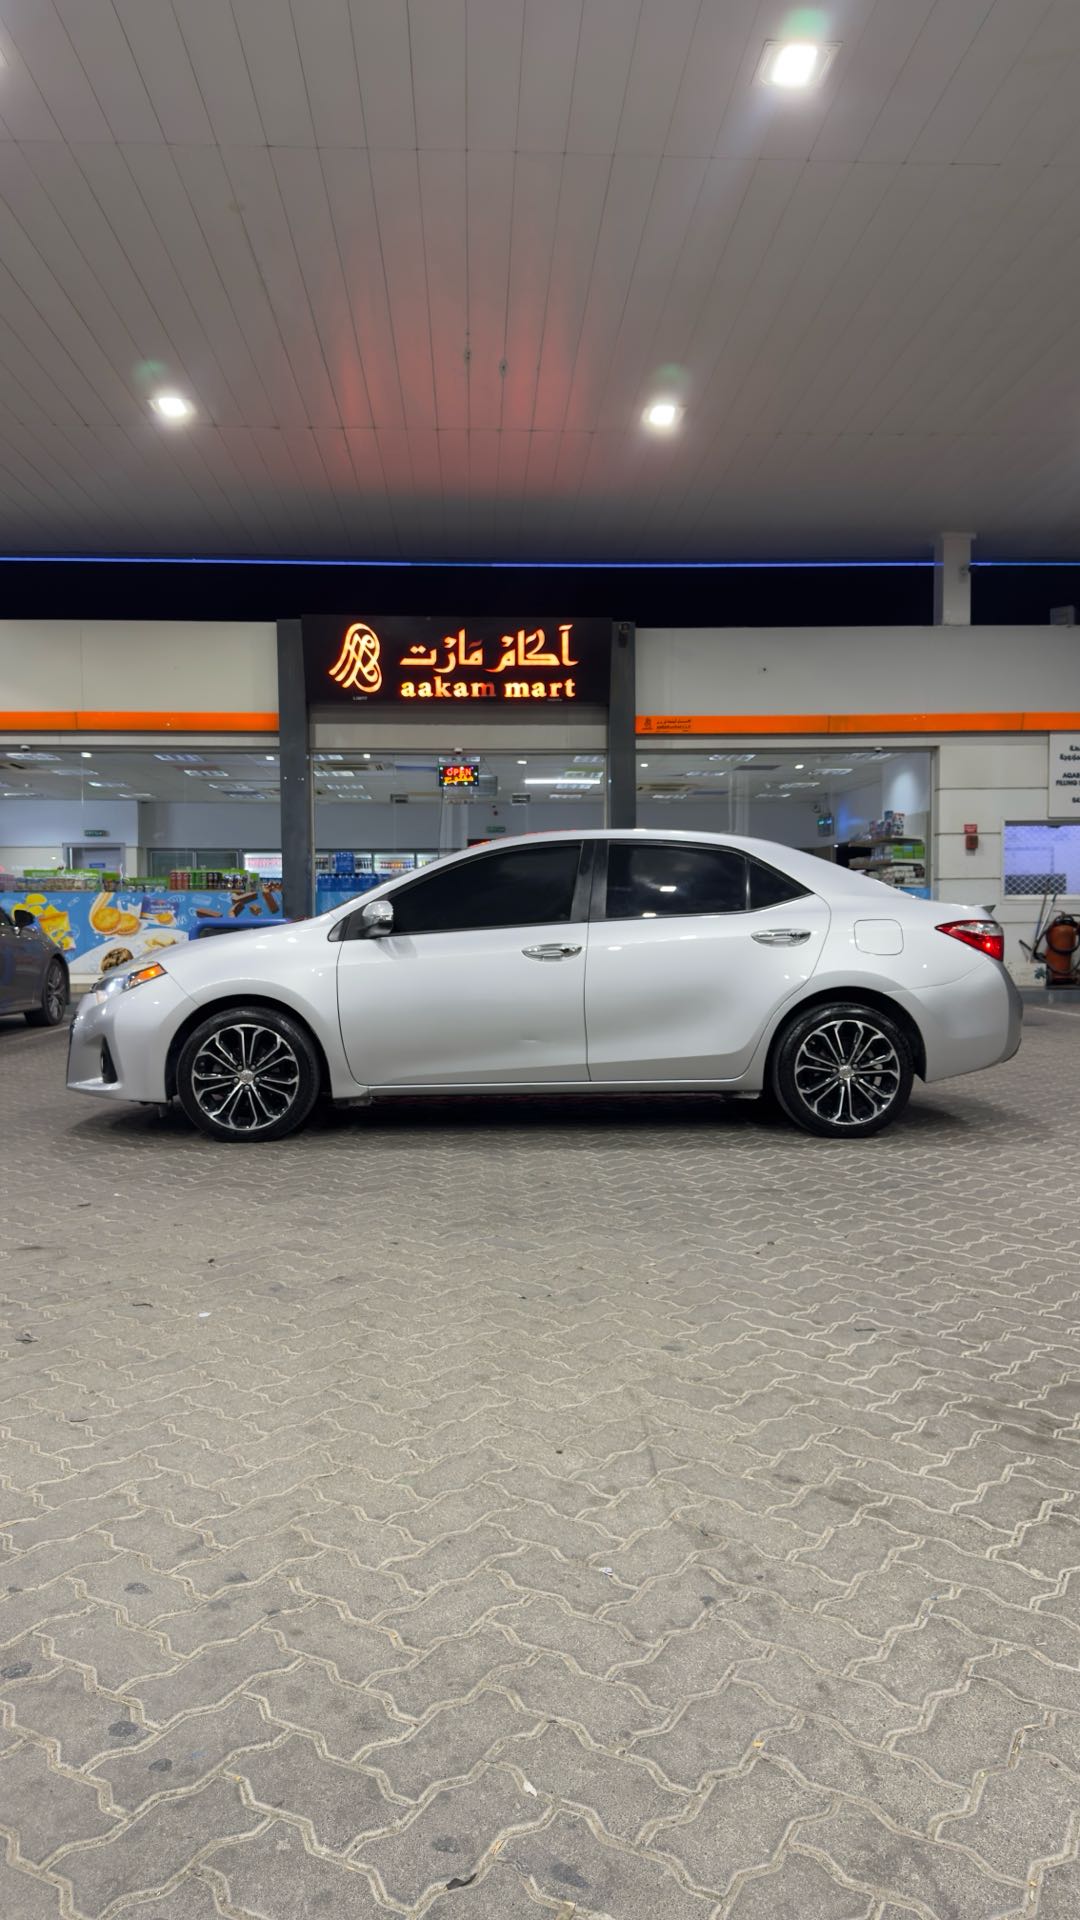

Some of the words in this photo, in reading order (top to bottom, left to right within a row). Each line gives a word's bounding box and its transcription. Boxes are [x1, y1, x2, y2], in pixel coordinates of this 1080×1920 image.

[400, 675, 497, 698] aakam
[503, 678, 577, 698] mart
[446, 767, 472, 776] OPEN
